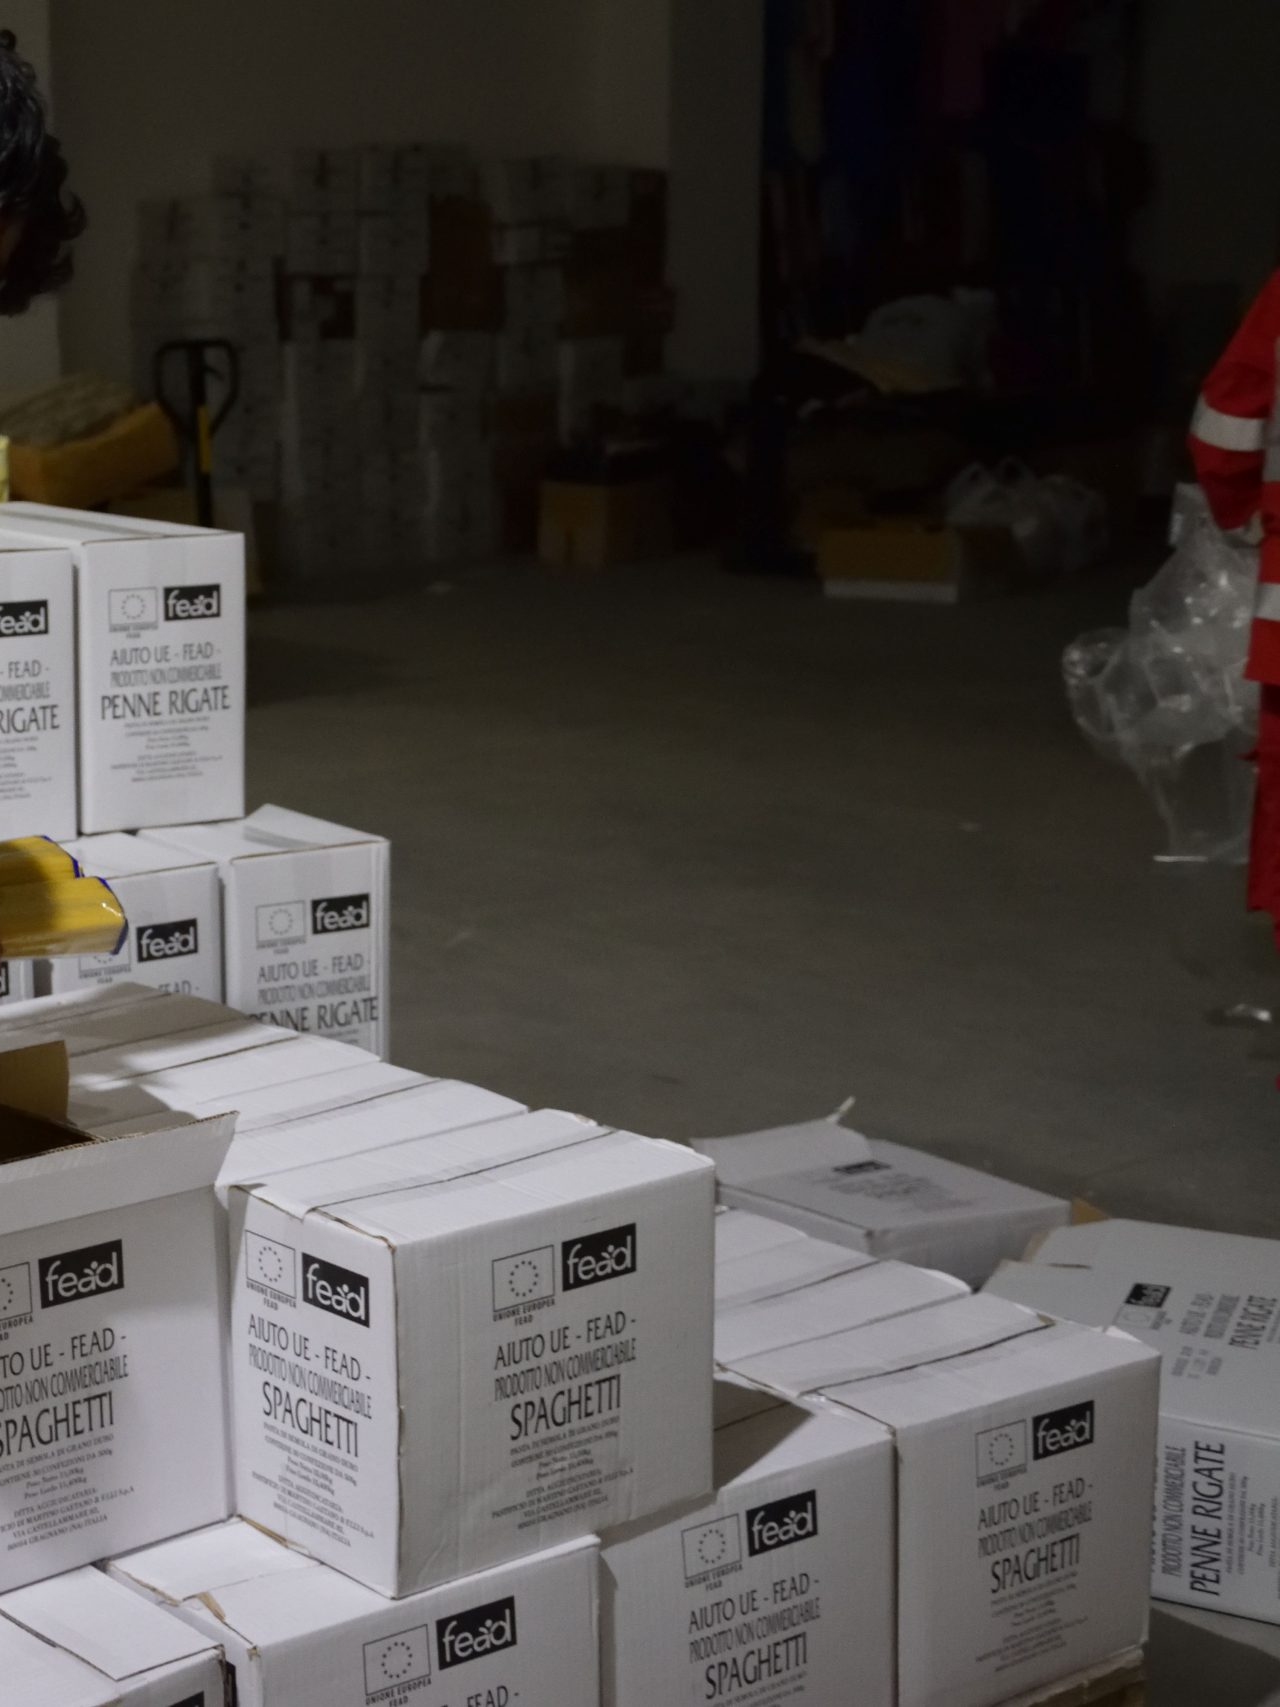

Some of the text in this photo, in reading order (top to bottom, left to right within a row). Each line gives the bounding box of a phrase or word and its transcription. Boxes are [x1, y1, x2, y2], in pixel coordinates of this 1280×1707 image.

[167, 589, 218, 618] fead
[8, 659, 41, 680] FEAD
[110, 641, 214, 666] AIUTO UE FEAD
[101, 685, 231, 720] PENNE RIGATE
[315, 900, 367, 931] fead
[140, 926, 195, 959] fead
[257, 953, 364, 984] AIUTO UE FEAD
[317, 996, 379, 1030] RIGATE
[45, 1251, 119, 1302] fead
[567, 1235, 632, 1285] fead
[246, 1280, 297, 1309] UNIONE EUROPEA
[306, 1262, 366, 1321] fead
[493, 1298, 556, 1322] UNIONE EUROPEA
[494, 1333, 546, 1371] AIUTO
[550, 1326, 571, 1354] UE
[587, 1310, 626, 1344] FEAD
[514, 1314, 534, 1327] FEAD
[30, 1343, 54, 1371] UE
[71, 1327, 116, 1360] FEAD
[248, 1313, 289, 1351] AIUTO
[293, 1332, 311, 1361] UE
[324, 1345, 361, 1382] FEAD
[495, 1337, 636, 1402] PRODOTTO NON COMMERCIABILE
[25, 1376, 49, 1405] NON
[51, 1354, 128, 1398] COMMERCIABILE
[248, 1342, 372, 1420] PRODOTTO NON COMMERCIABILE
[262, 1380, 359, 1458] SPAGHETTI
[510, 1373, 621, 1441] SPAGHETTI
[1036, 1410, 1091, 1455] fead
[752, 1500, 814, 1551] fead
[977, 1497, 1020, 1531] AIUTO
[1023, 1491, 1041, 1516] UE
[1052, 1477, 1085, 1507] FEAD
[1162, 1514, 1183, 1532] NON
[1190, 1440, 1225, 1596] PENNE RIGATE
[990, 1532, 1081, 1594] SPAGHETTI
[688, 1597, 736, 1635] AIUTO
[739, 1589, 760, 1616] UE
[773, 1572, 810, 1605] FEAD
[442, 1608, 512, 1663] fead
[705, 1631, 808, 1700] SPAGHETTI
[366, 1677, 432, 1706] UNIONE EUROPEA
[389, 1695, 409, 1707] FEAD
